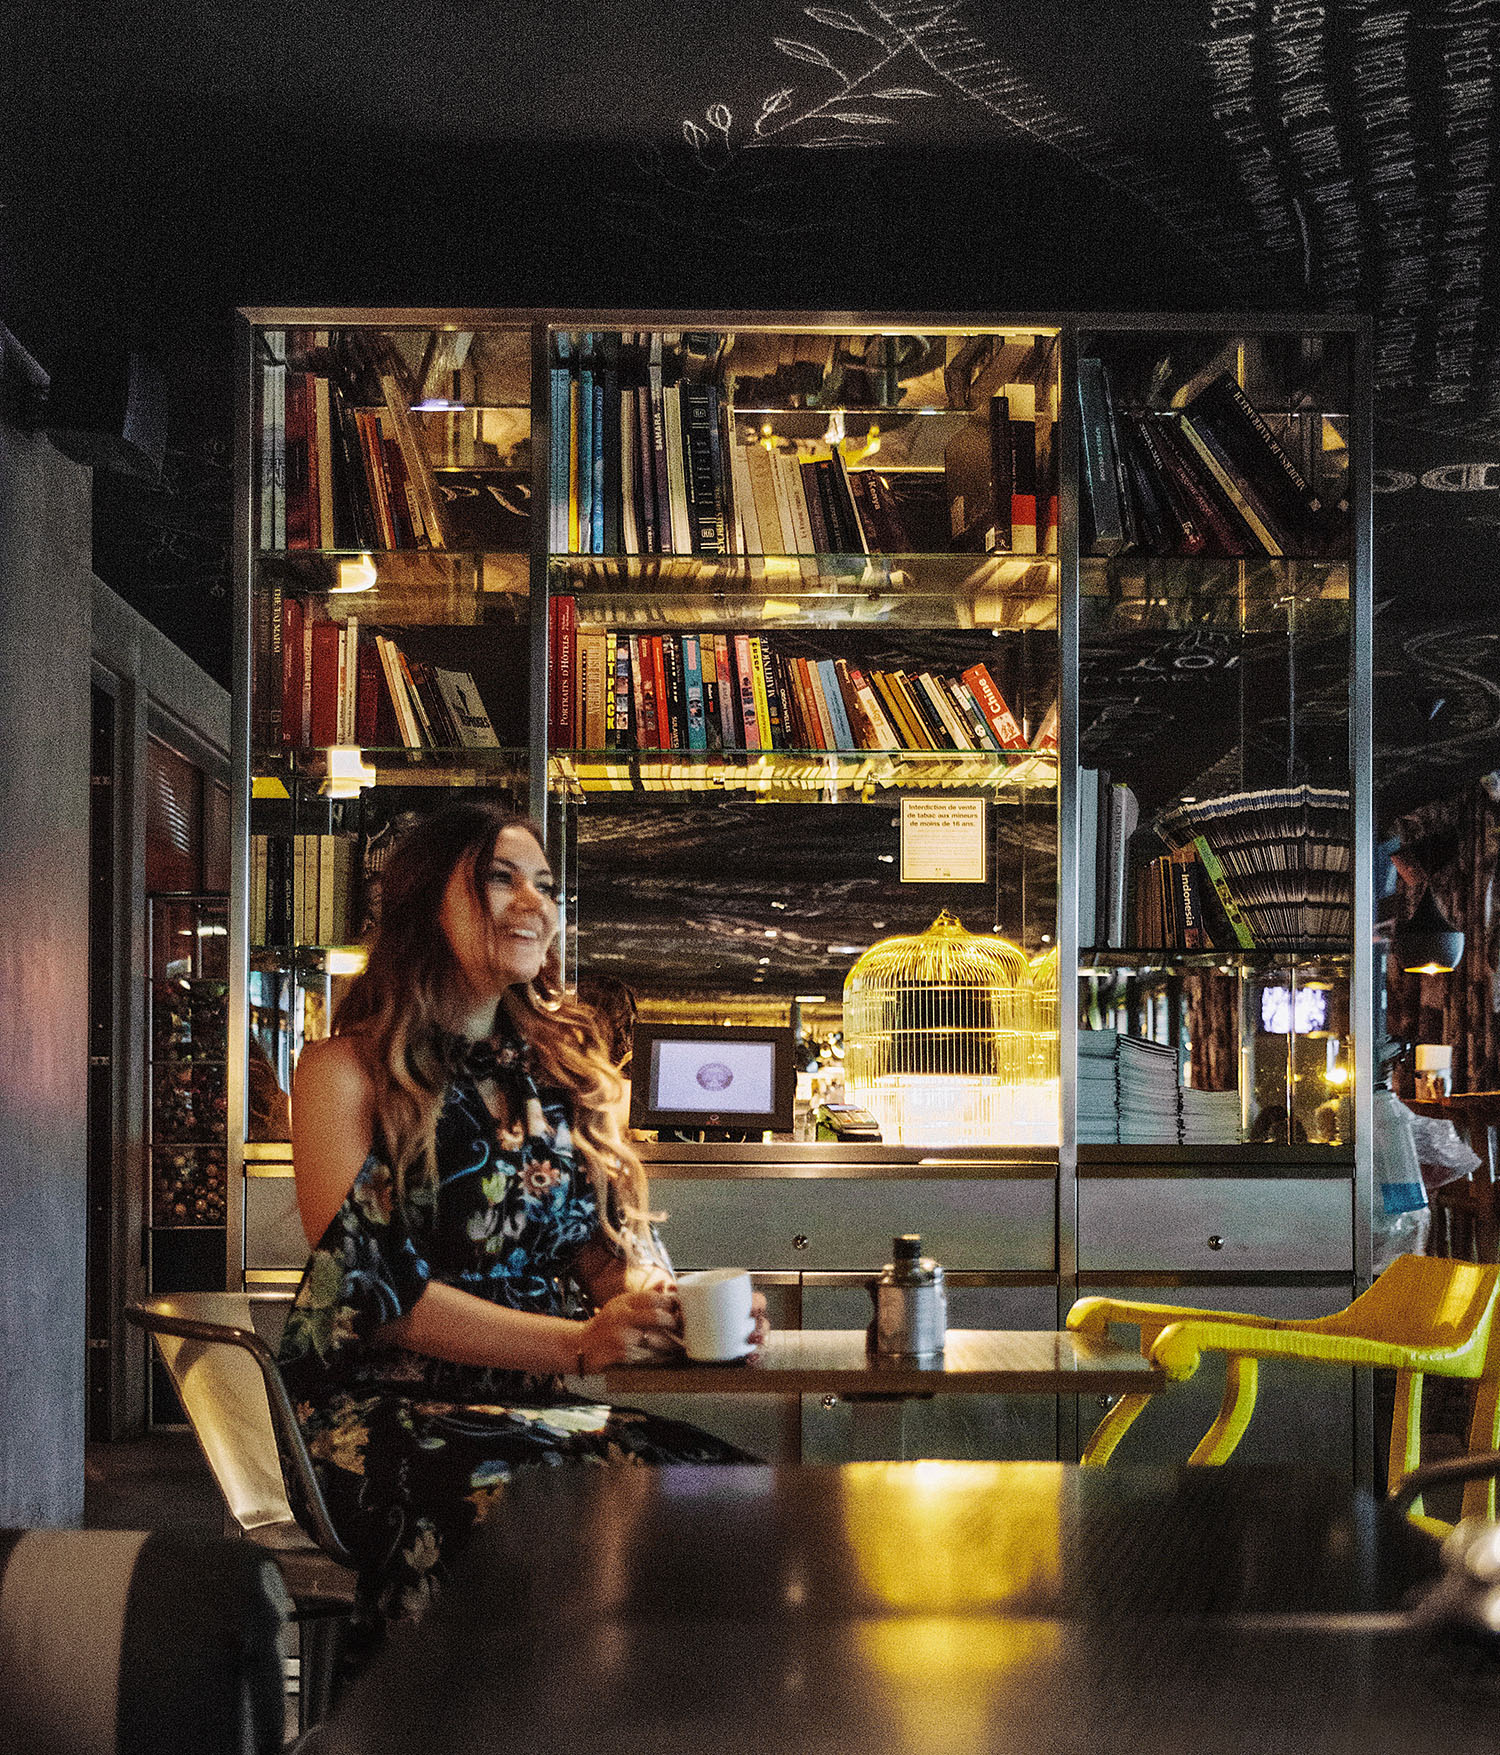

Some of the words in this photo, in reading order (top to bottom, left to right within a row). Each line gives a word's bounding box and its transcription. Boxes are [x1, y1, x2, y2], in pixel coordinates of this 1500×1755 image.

[1352, 11, 1411, 42] UN
[1279, 84, 1331, 127] UNE
[654, 413, 663, 450] SAHARA
[1232, 392, 1275, 443] MARRAKECH
[1268, 440, 1281, 455] DE
[1278, 453, 1306, 491] MEDERSA
[868, 481, 881, 511] Kenya
[762, 637, 775, 698] MARTINIQUE
[607, 678, 615, 729] PACK
[780, 688, 788, 709] ORSON
[979, 678, 1001, 714] Chine
[783, 710, 791, 733] WELLES
[1181, 874, 1193, 926] Indonesia
